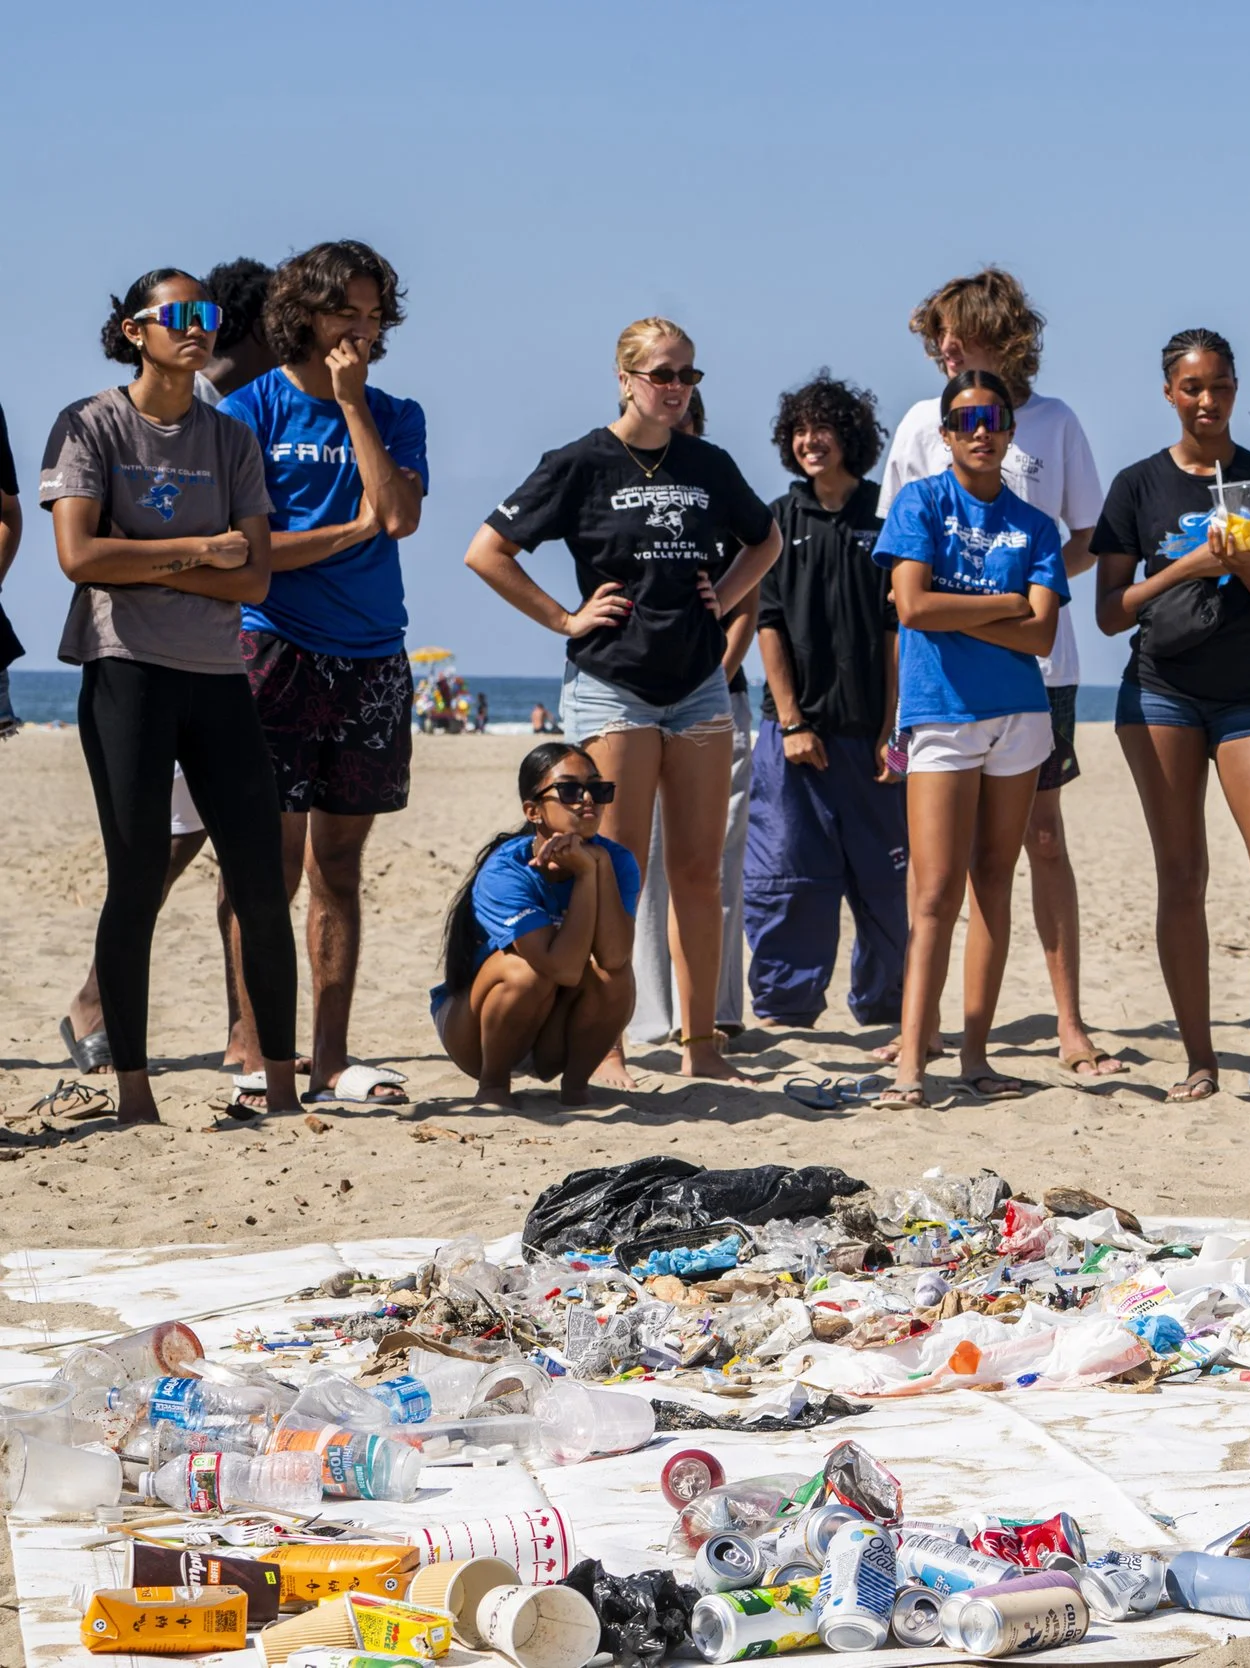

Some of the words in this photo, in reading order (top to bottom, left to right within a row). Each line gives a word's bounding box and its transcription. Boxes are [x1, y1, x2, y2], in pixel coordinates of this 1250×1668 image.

[178, 468, 212, 477] COLLEGE
[610, 490, 710, 511] CORSAIRS
[633, 550, 708, 560] VOLLEYBALL
[653, 541, 696, 549] BEACH
[331, 1447, 343, 1482] COOL
[869, 1536, 897, 1560] Ope
[210, 1560, 220, 1585] COFFEE
[862, 1547, 897, 1577] Wate
[1065, 1603, 1078, 1641] COLO
[384, 1620, 393, 1650] JUICE
[390, 1621, 401, 1651] 100%
